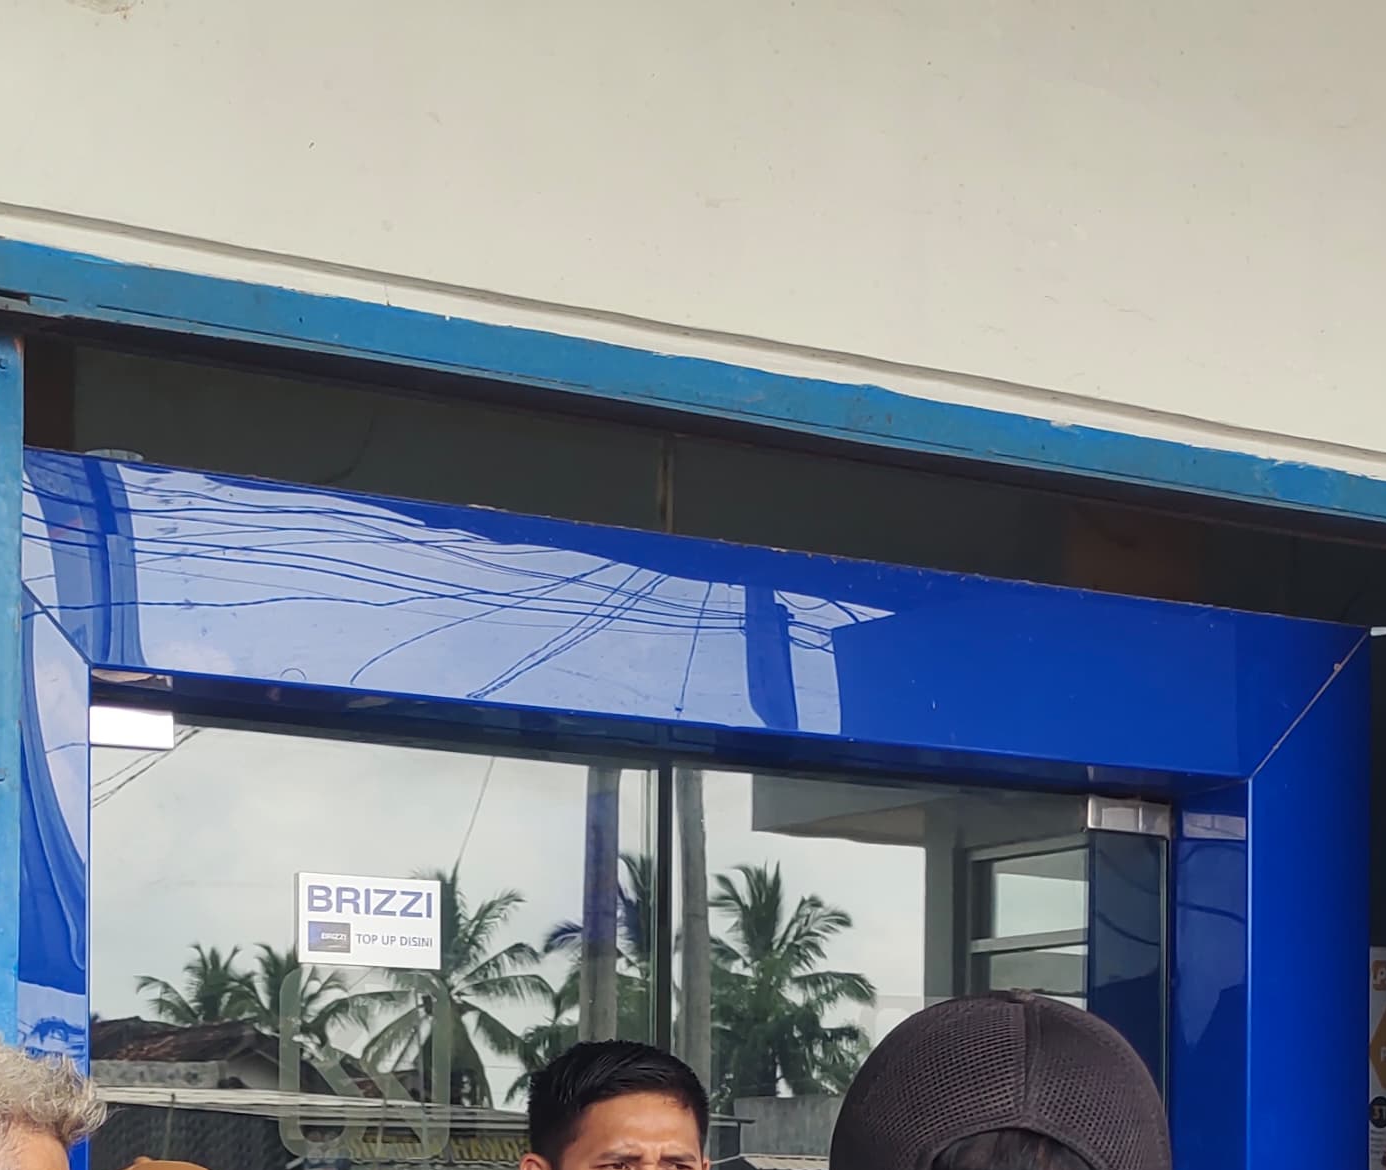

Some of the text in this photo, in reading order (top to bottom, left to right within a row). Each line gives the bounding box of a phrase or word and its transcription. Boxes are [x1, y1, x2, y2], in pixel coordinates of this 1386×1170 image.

[307, 885, 433, 919] BRIZZI
[355, 933, 433, 948] TOP UP DISINI
